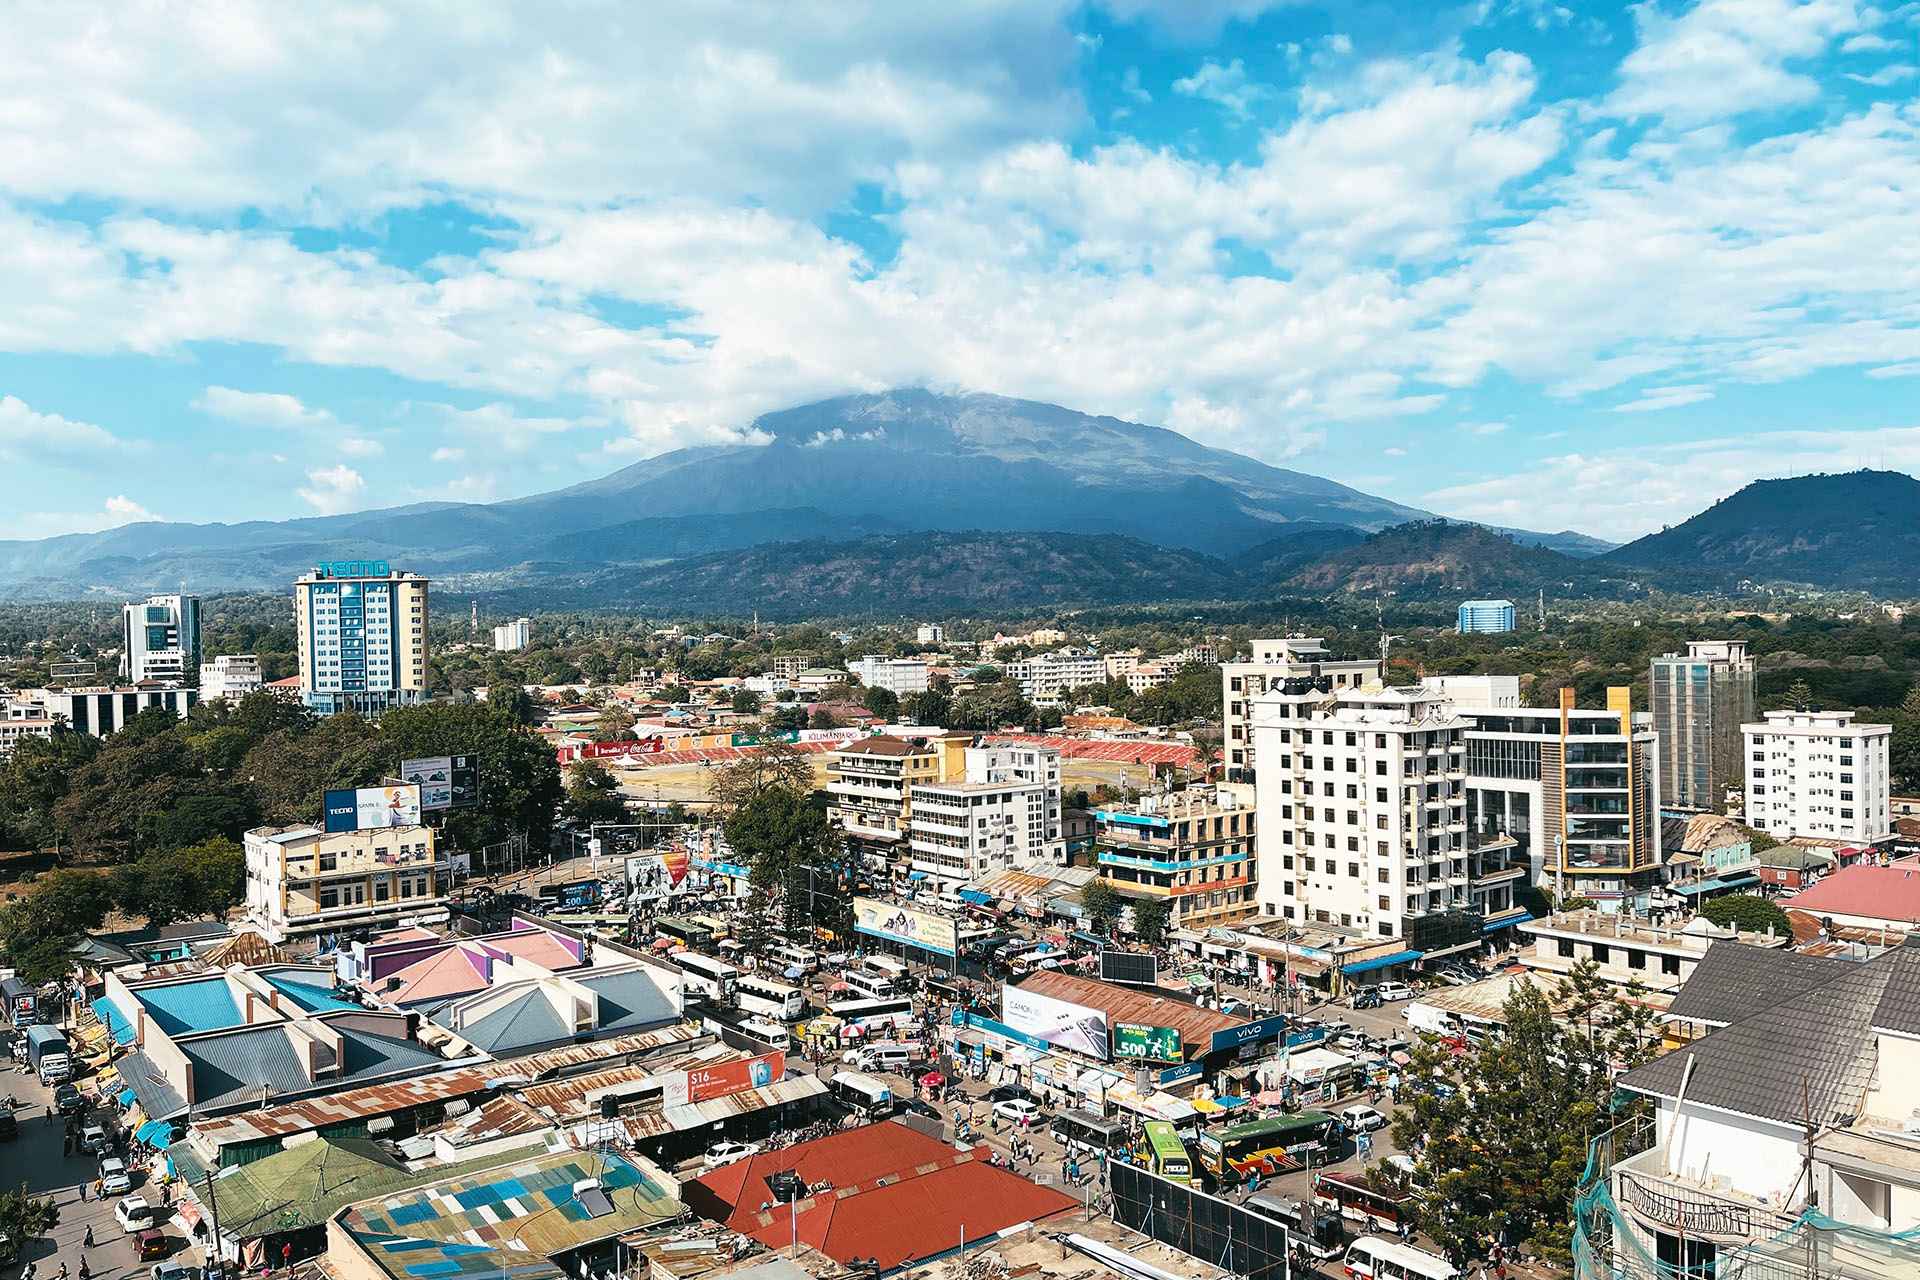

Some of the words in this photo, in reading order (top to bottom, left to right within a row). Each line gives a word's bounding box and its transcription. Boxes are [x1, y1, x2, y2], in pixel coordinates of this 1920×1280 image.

[319, 561, 389, 577] TECNO
[329, 807, 353, 815] TECNO
[1236, 1025, 1262, 1039] vivo
[1298, 1032, 1313, 1042] vivo
[1026, 1035, 1040, 1047] vivo
[1121, 1042, 1147, 1056] 500
[1174, 1066, 1191, 1076] vivo
[691, 1071, 710, 1084] S16
